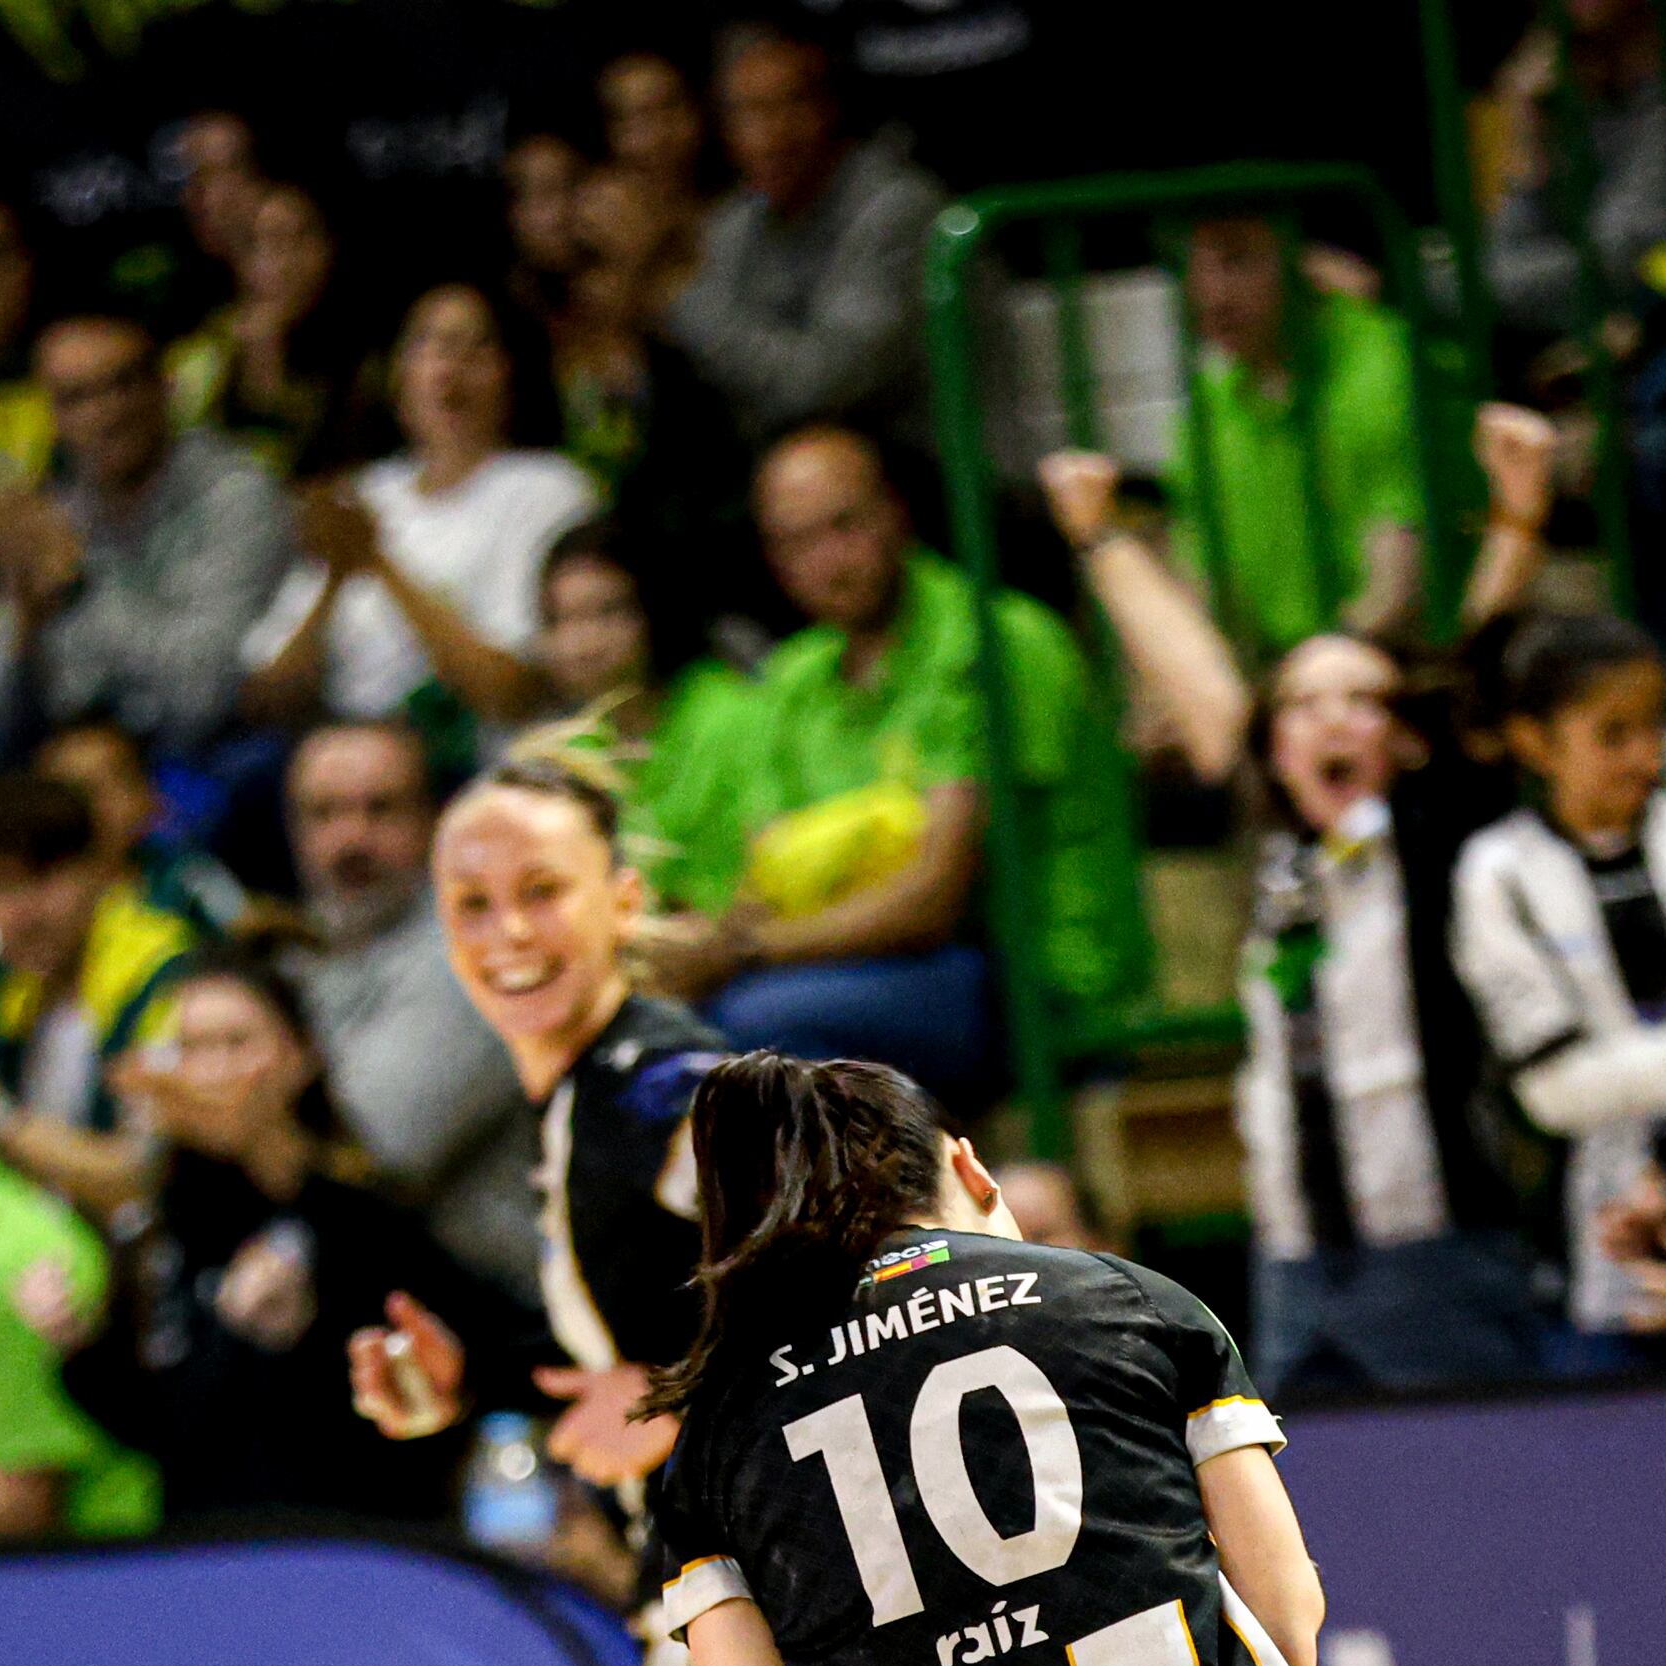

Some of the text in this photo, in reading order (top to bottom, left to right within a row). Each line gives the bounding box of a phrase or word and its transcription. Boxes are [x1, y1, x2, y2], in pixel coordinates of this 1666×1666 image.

[769, 1272, 1042, 1387] S. JIMÉNEZ
[782, 1344, 1083, 1628] 10
